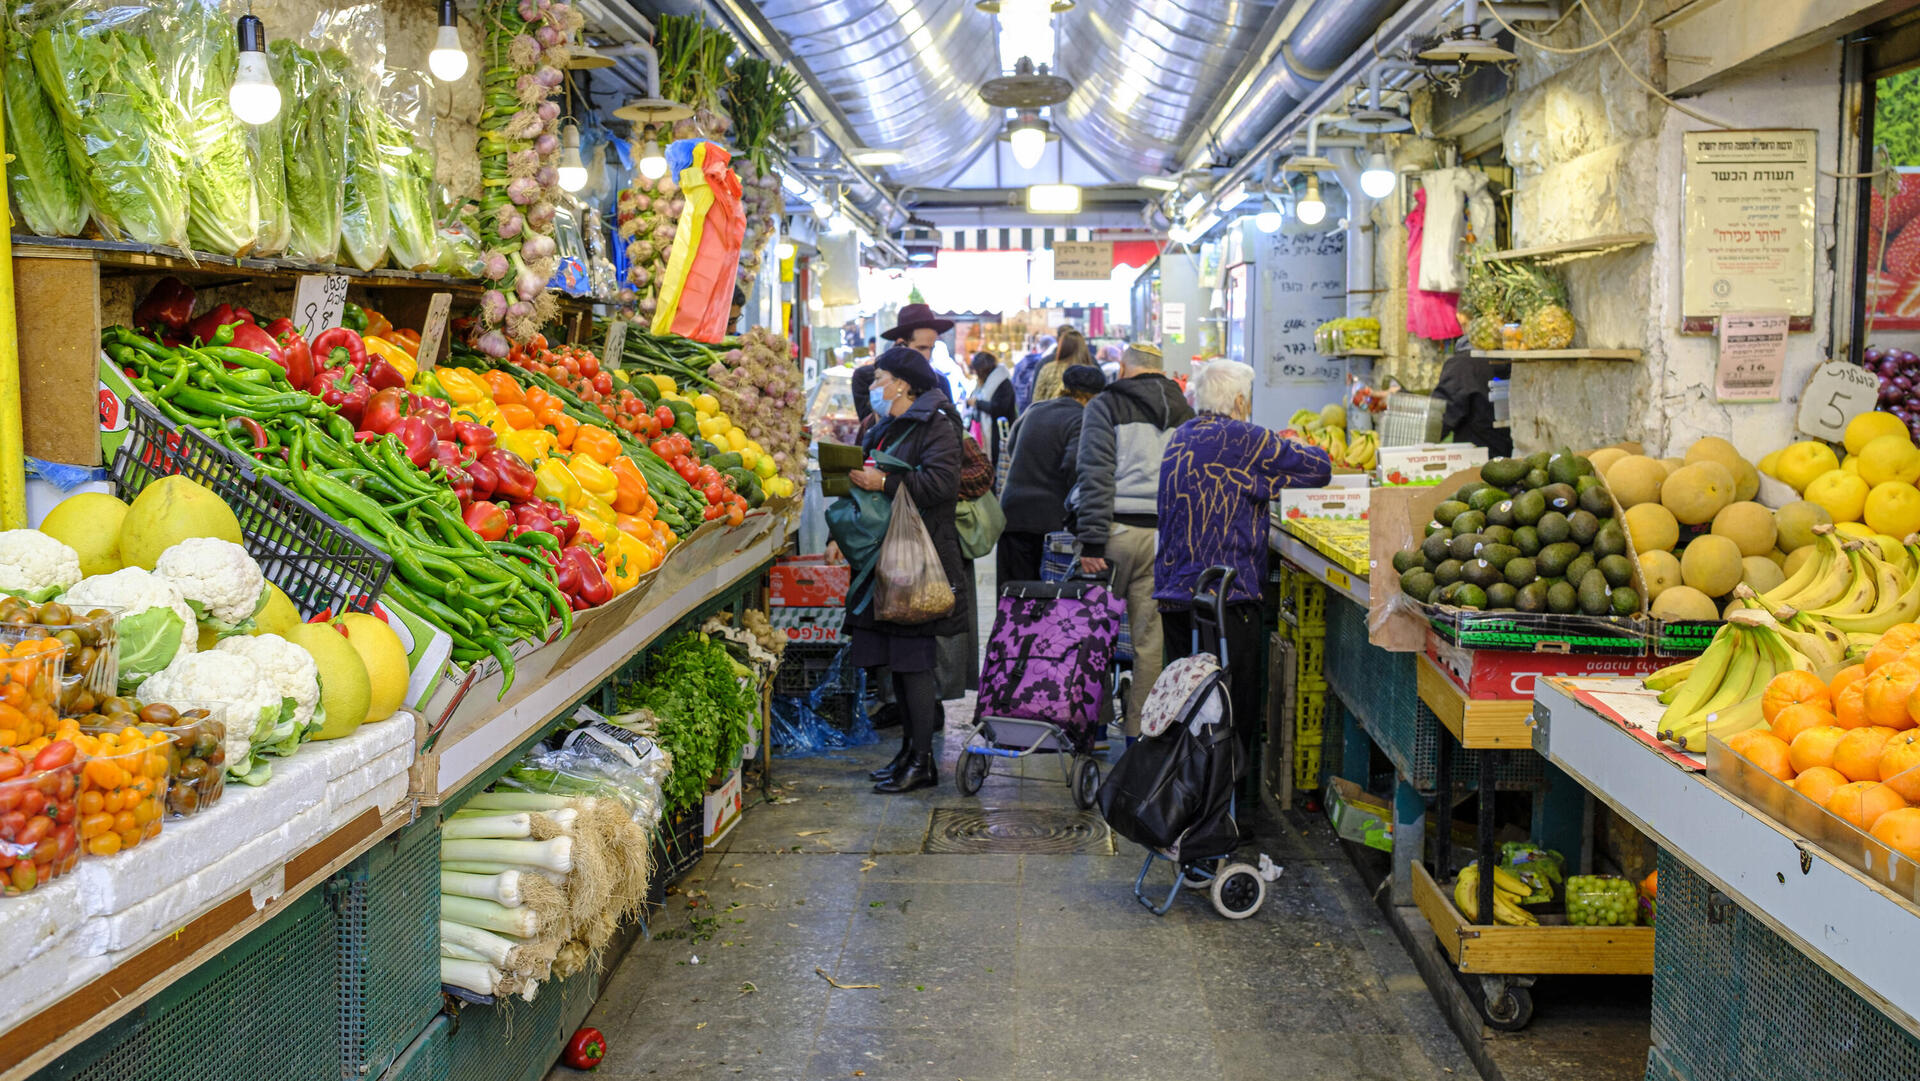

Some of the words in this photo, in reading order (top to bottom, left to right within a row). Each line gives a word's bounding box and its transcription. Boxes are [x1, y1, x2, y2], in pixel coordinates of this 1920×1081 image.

[1711, 171, 1748, 181] הכשר
[1753, 170, 1795, 181] תעודת
[1819, 391, 1852, 430] 5
[1463, 619, 1517, 631] PRETTY
[1664, 625, 1720, 636] PRETTY
